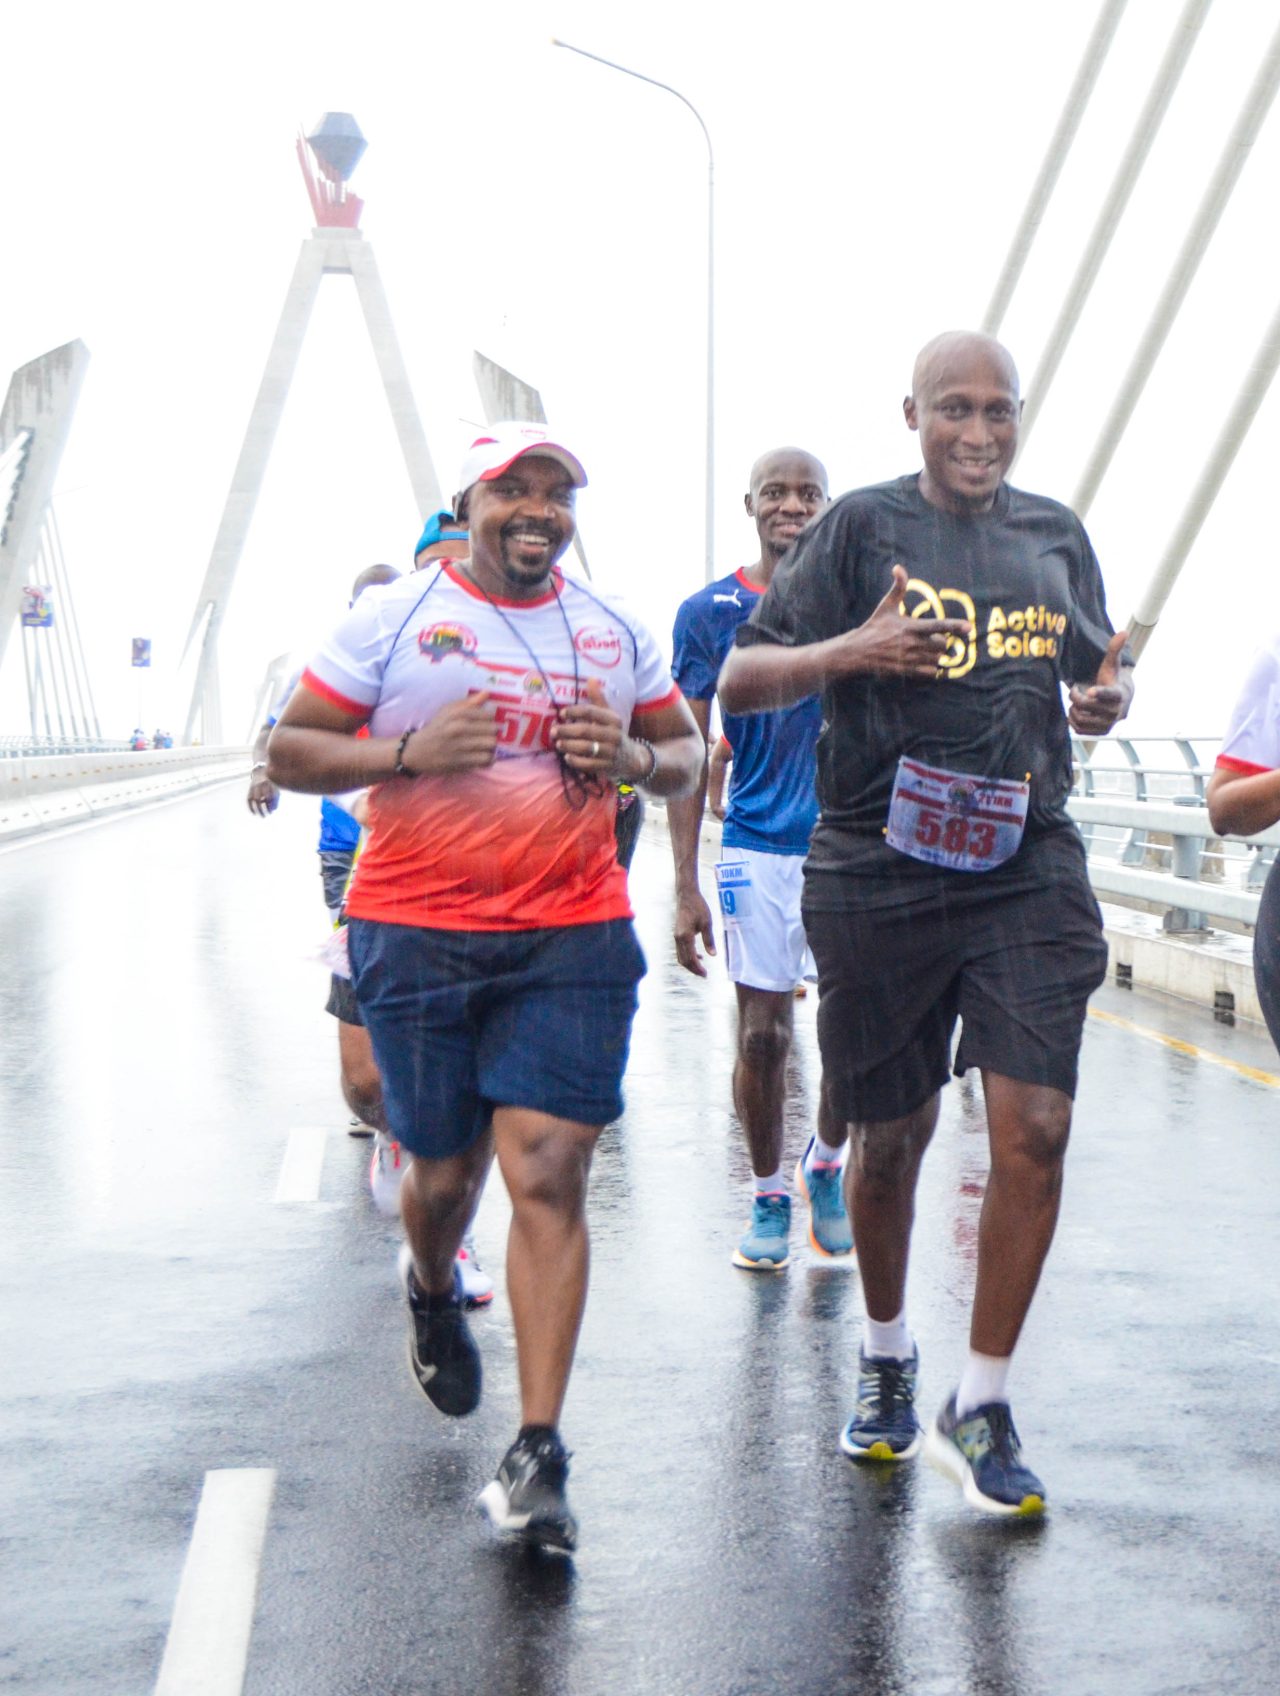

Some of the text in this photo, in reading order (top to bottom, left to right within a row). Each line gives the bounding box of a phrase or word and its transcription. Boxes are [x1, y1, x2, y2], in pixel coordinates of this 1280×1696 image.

[987, 605, 1067, 636] Active
[986, 630, 1057, 659] Soles
[915, 811, 996, 859] 583
